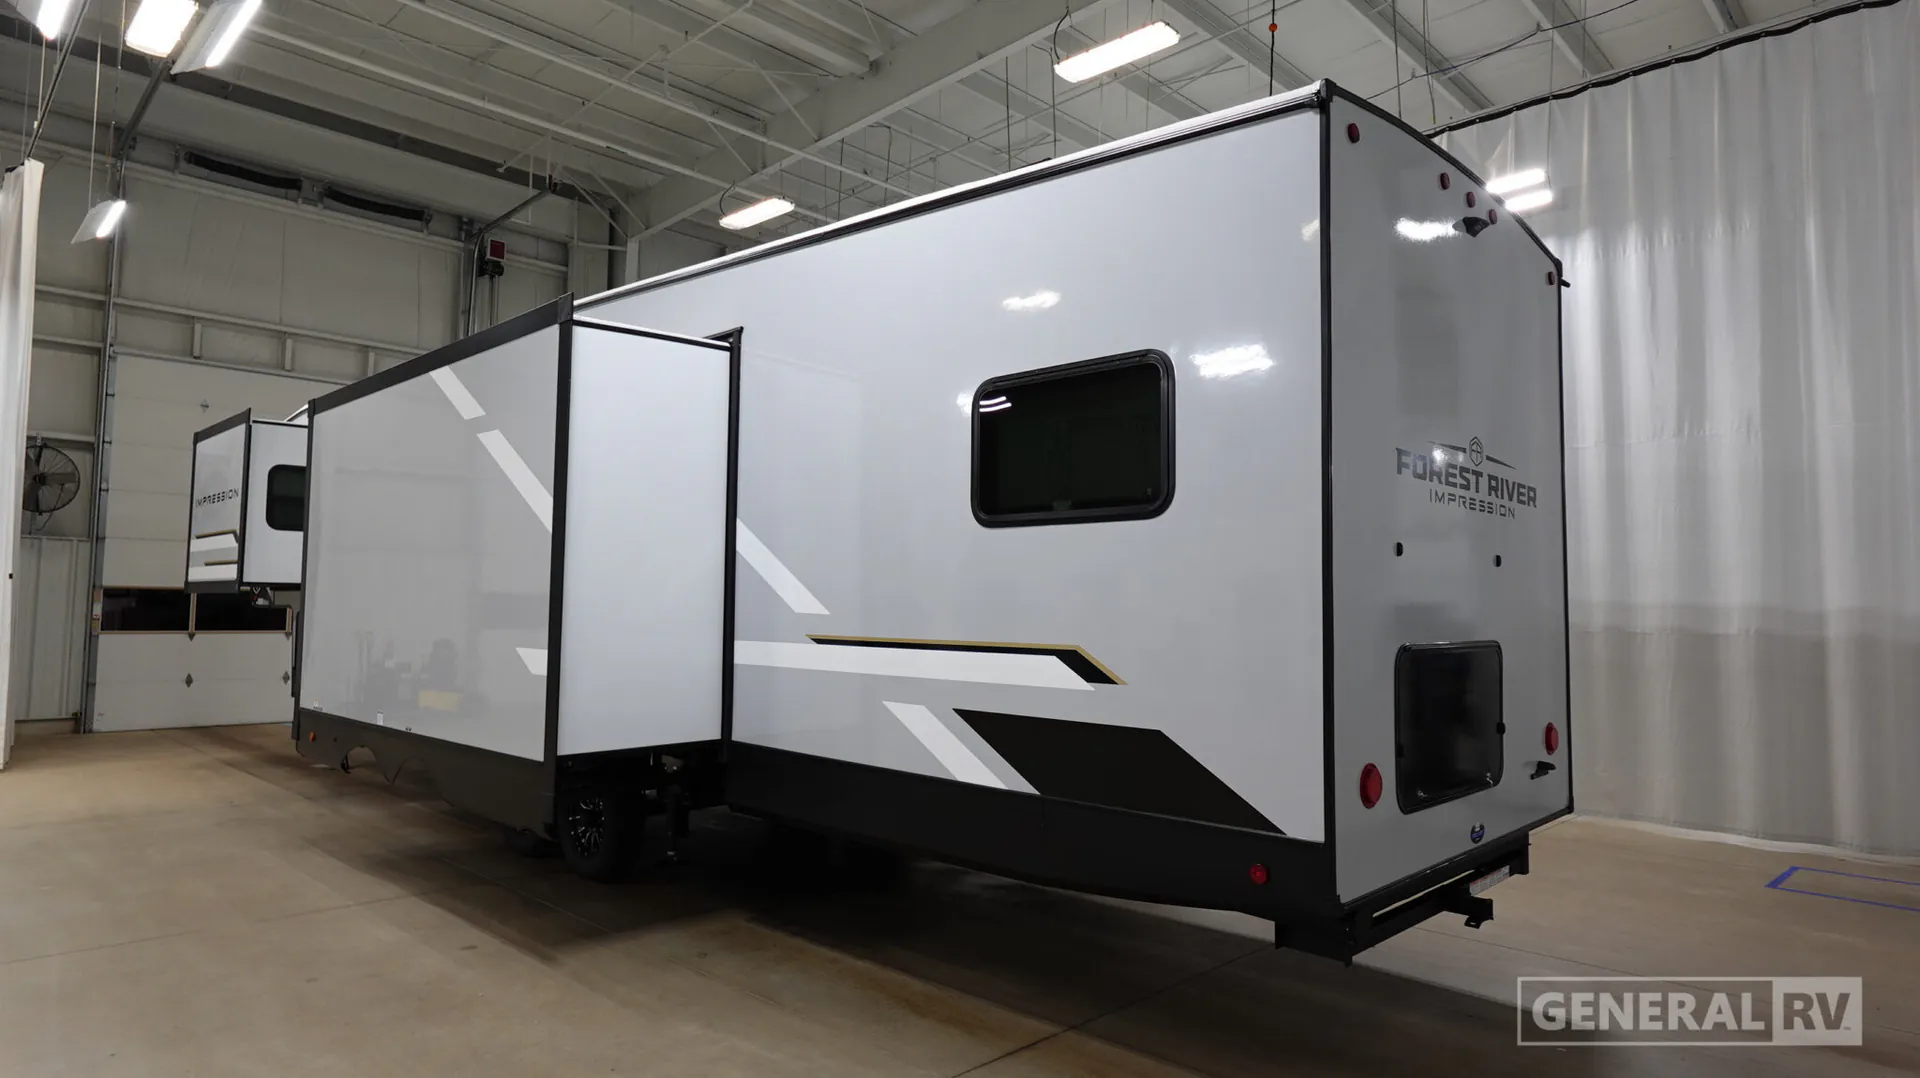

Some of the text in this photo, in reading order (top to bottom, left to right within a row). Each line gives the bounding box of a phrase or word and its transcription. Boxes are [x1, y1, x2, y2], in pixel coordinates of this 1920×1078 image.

[1396, 447, 1537, 508] FOREST RIVER
[195, 487, 239, 507] IMPRESSION
[1429, 488, 1515, 519] IMPRESSION
